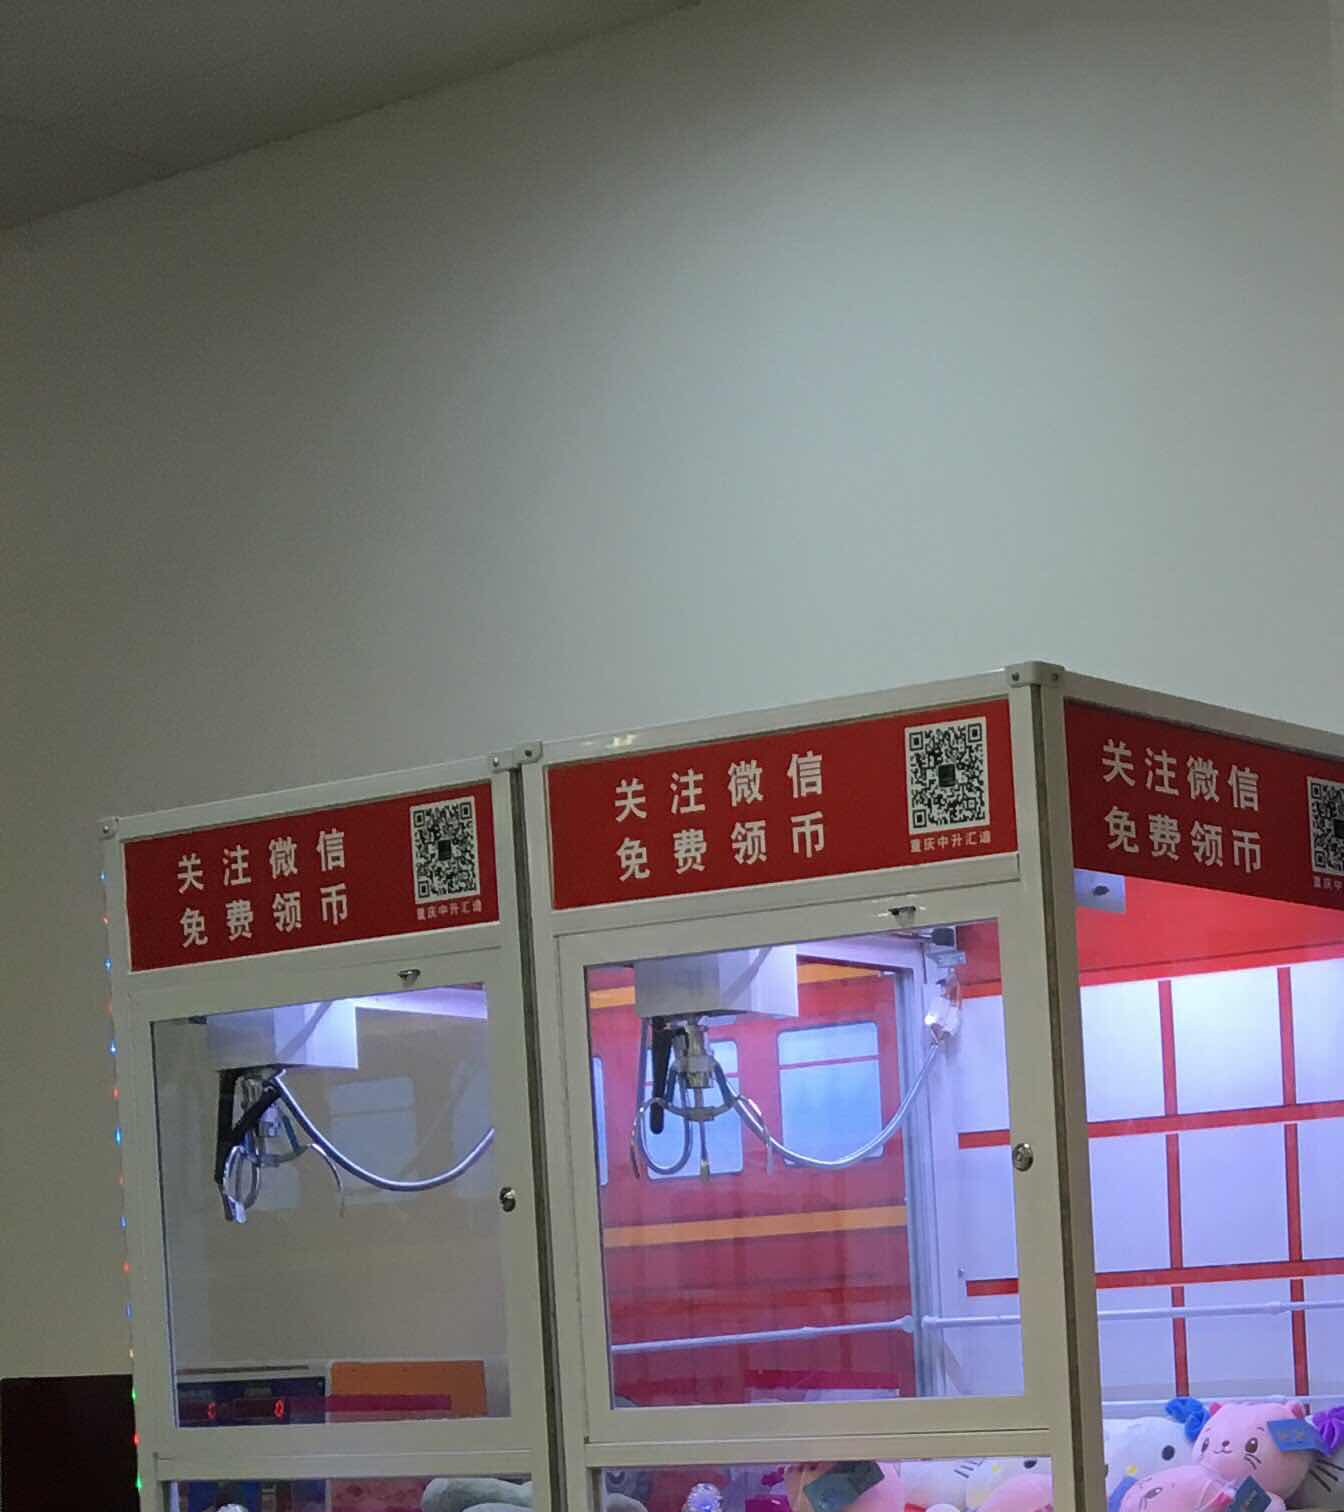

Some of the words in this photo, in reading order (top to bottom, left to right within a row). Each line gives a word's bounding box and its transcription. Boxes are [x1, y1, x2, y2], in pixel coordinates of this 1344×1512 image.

[615, 751, 824, 824] 关注微信
[1102, 738, 1261, 812] 关注微信
[177, 828, 347, 895] 关注微信
[616, 811, 827, 882] 免费领币
[1105, 806, 1263, 874] 免费领币
[180, 883, 350, 949] 免费领币
